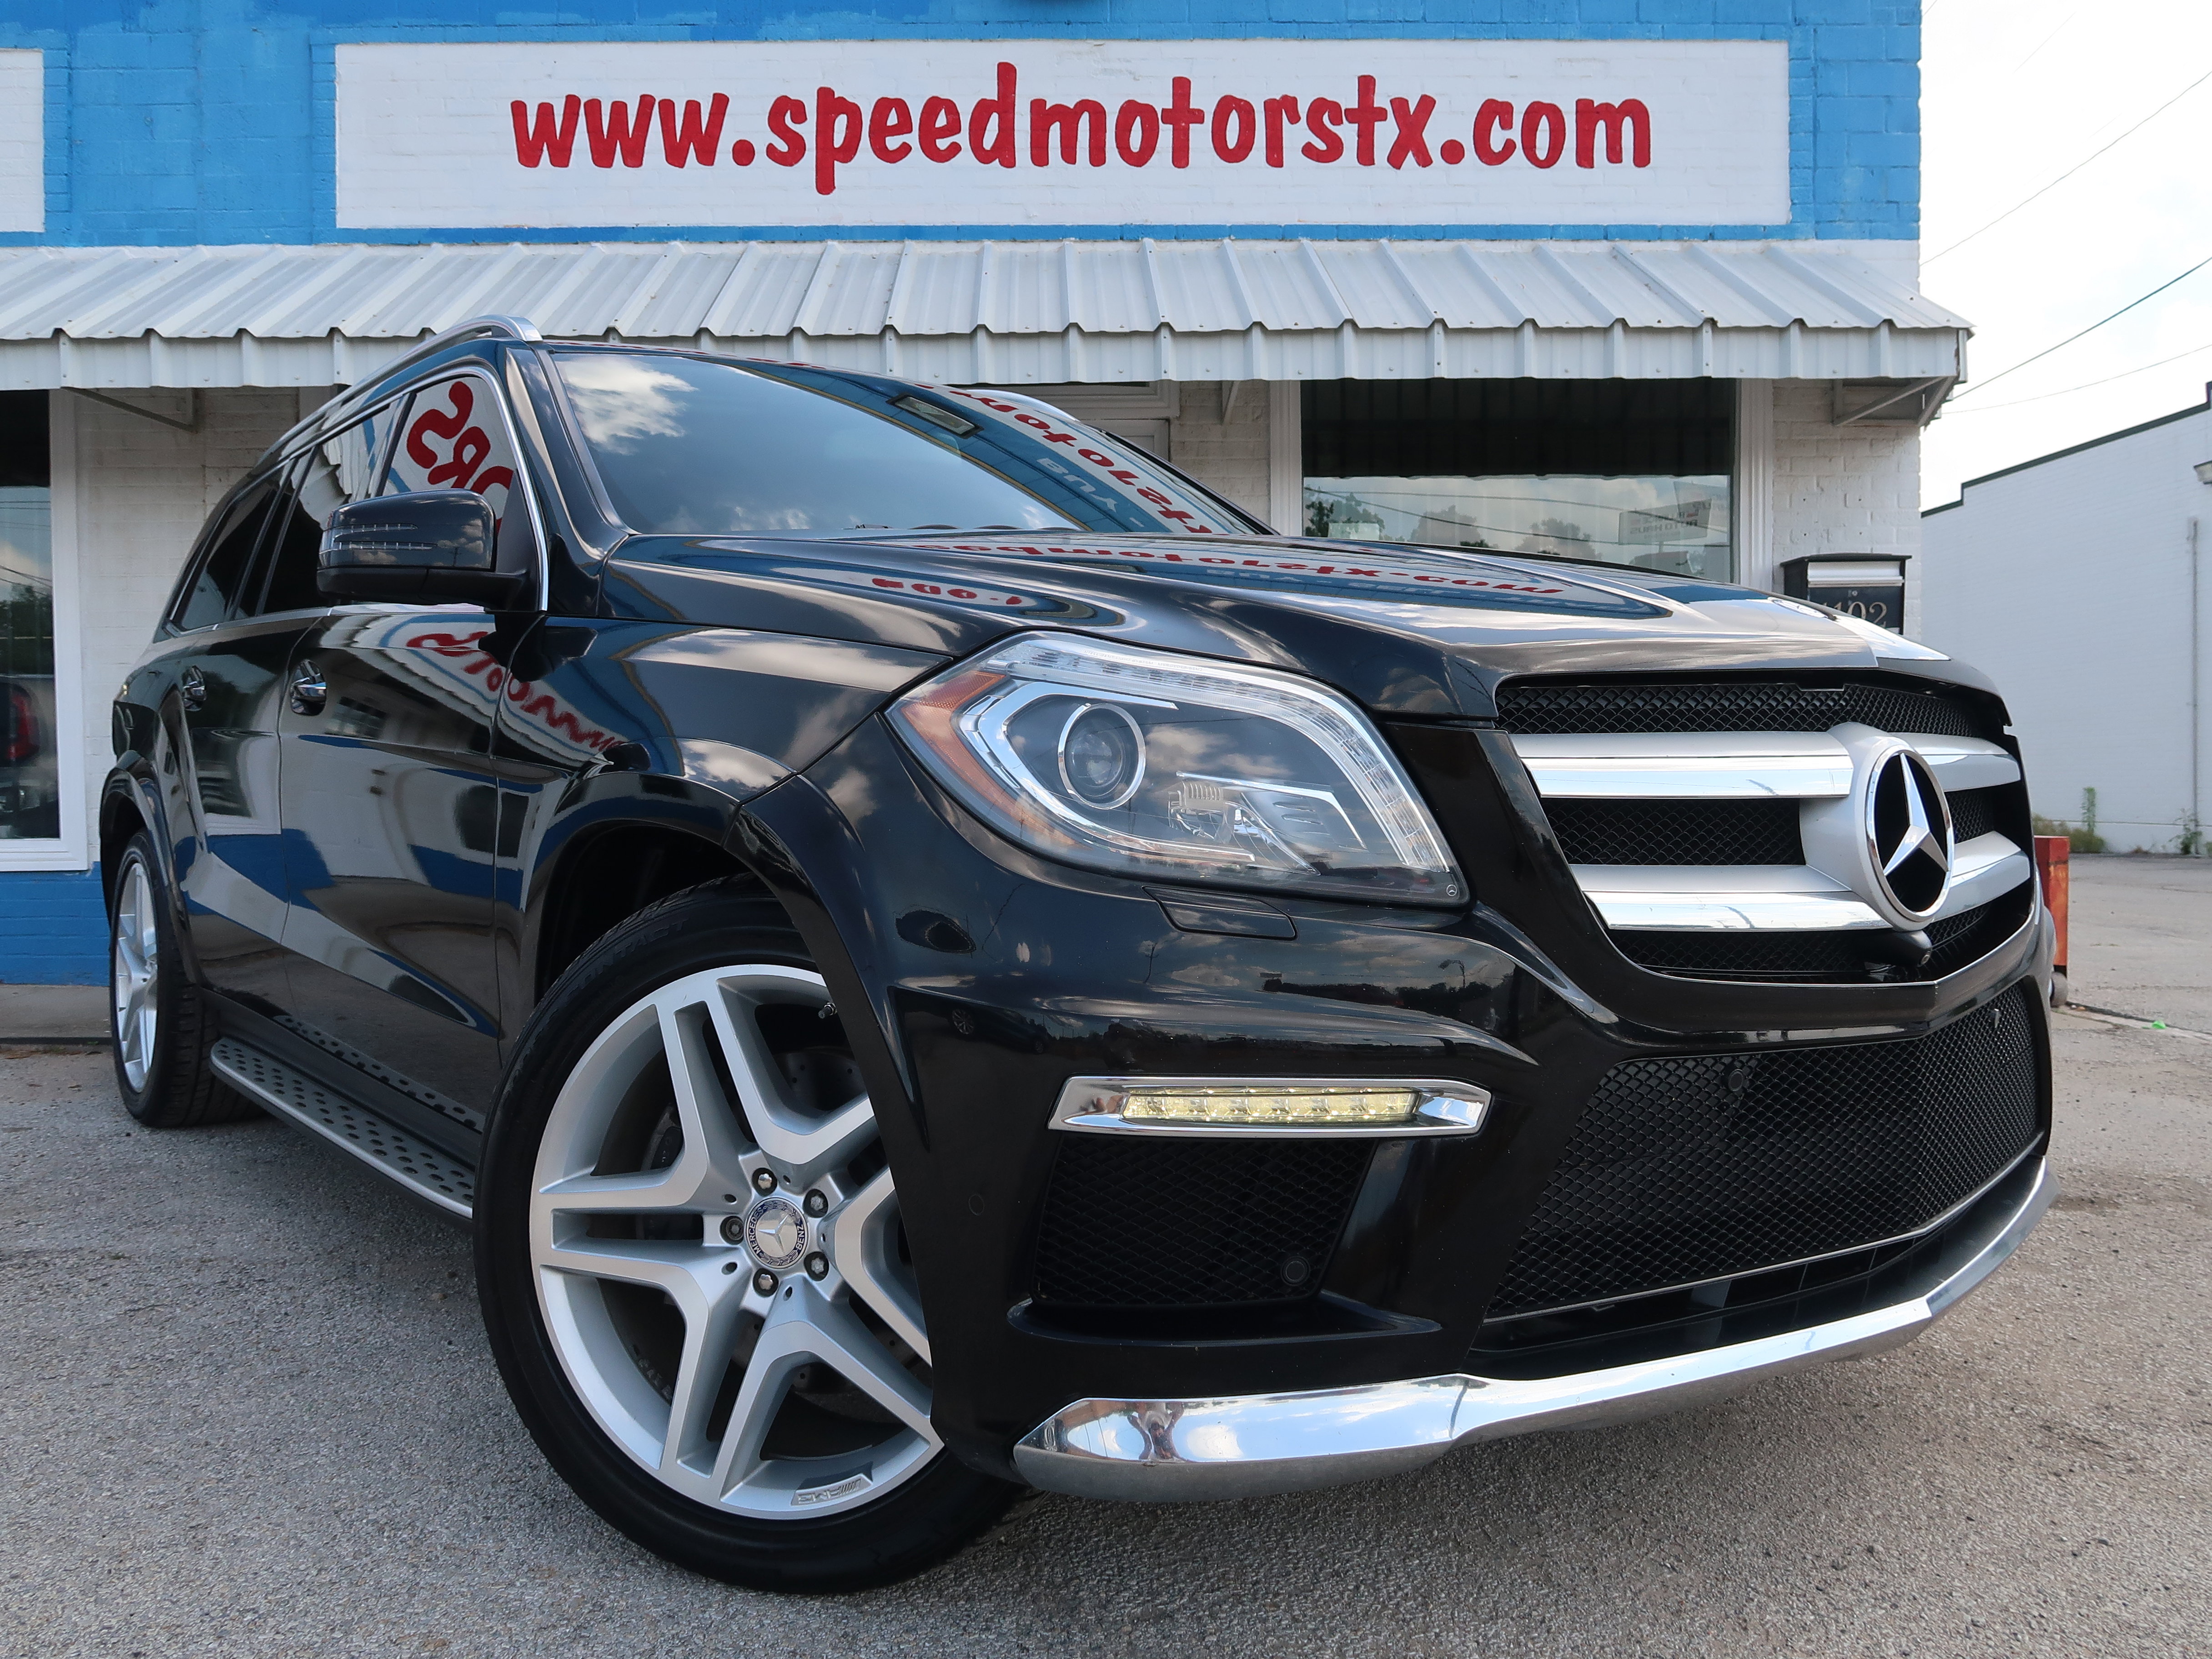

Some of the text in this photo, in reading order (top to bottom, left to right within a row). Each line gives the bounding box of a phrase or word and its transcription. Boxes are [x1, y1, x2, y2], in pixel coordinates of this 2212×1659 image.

[510, 62, 1651, 195] www.speedmotorstx.com
[749, 1207, 763, 1254] MERCEDES
[796, 1224, 804, 1250] BENZ
